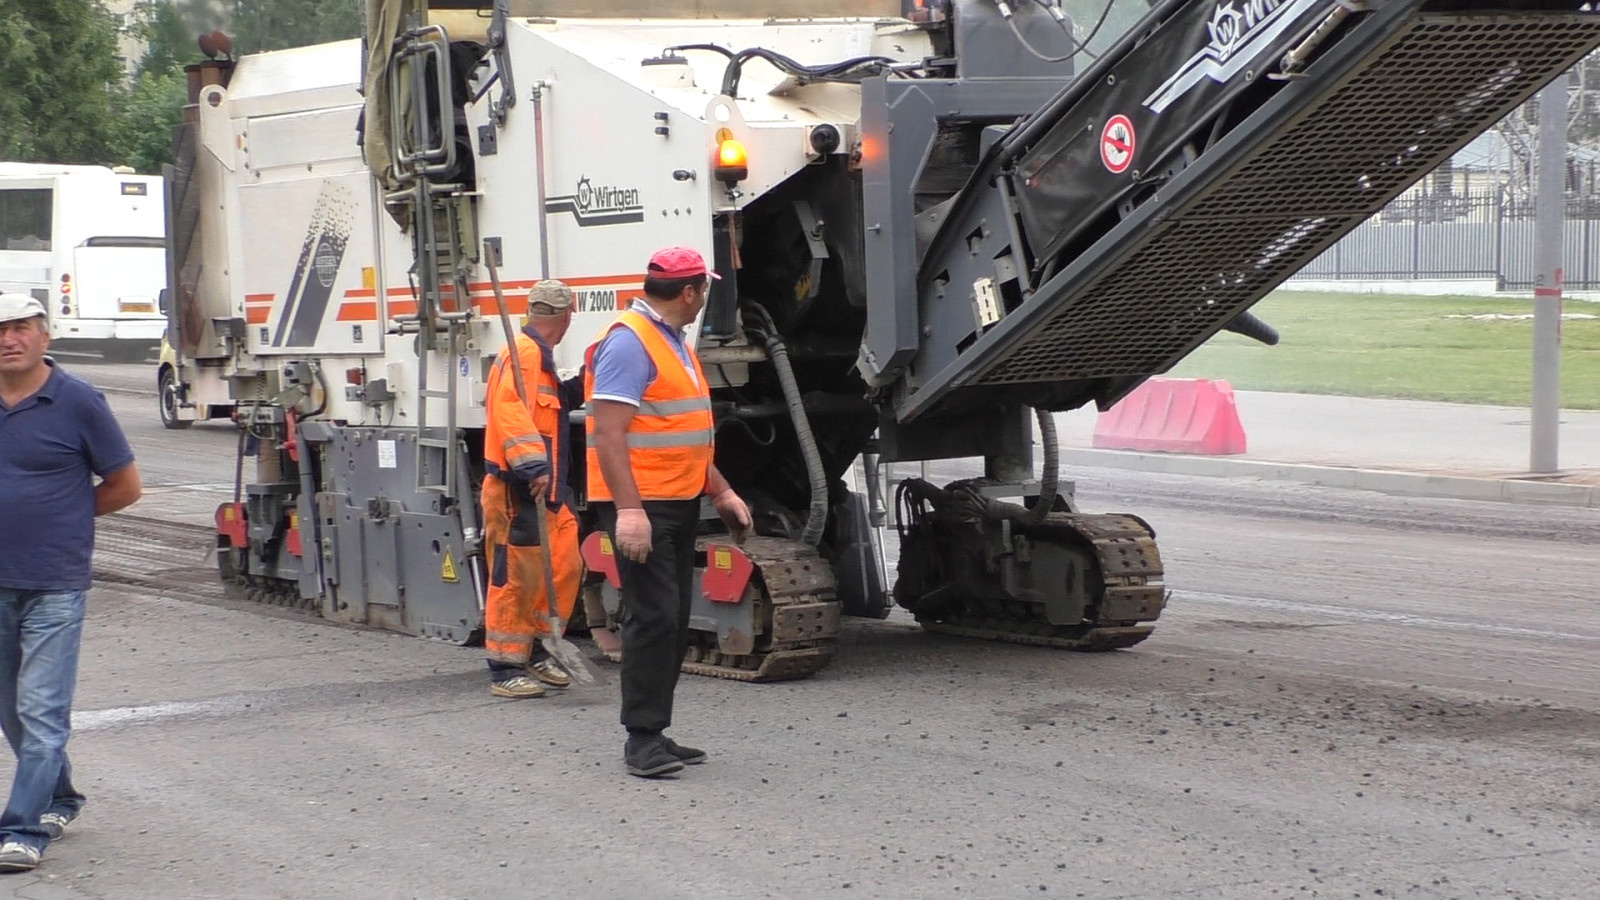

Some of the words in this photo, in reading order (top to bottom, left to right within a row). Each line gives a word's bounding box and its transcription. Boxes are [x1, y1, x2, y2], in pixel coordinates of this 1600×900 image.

[594, 186, 639, 212] Wirtgen
[578, 291, 588, 312] W
[590, 290, 615, 312] 2000
